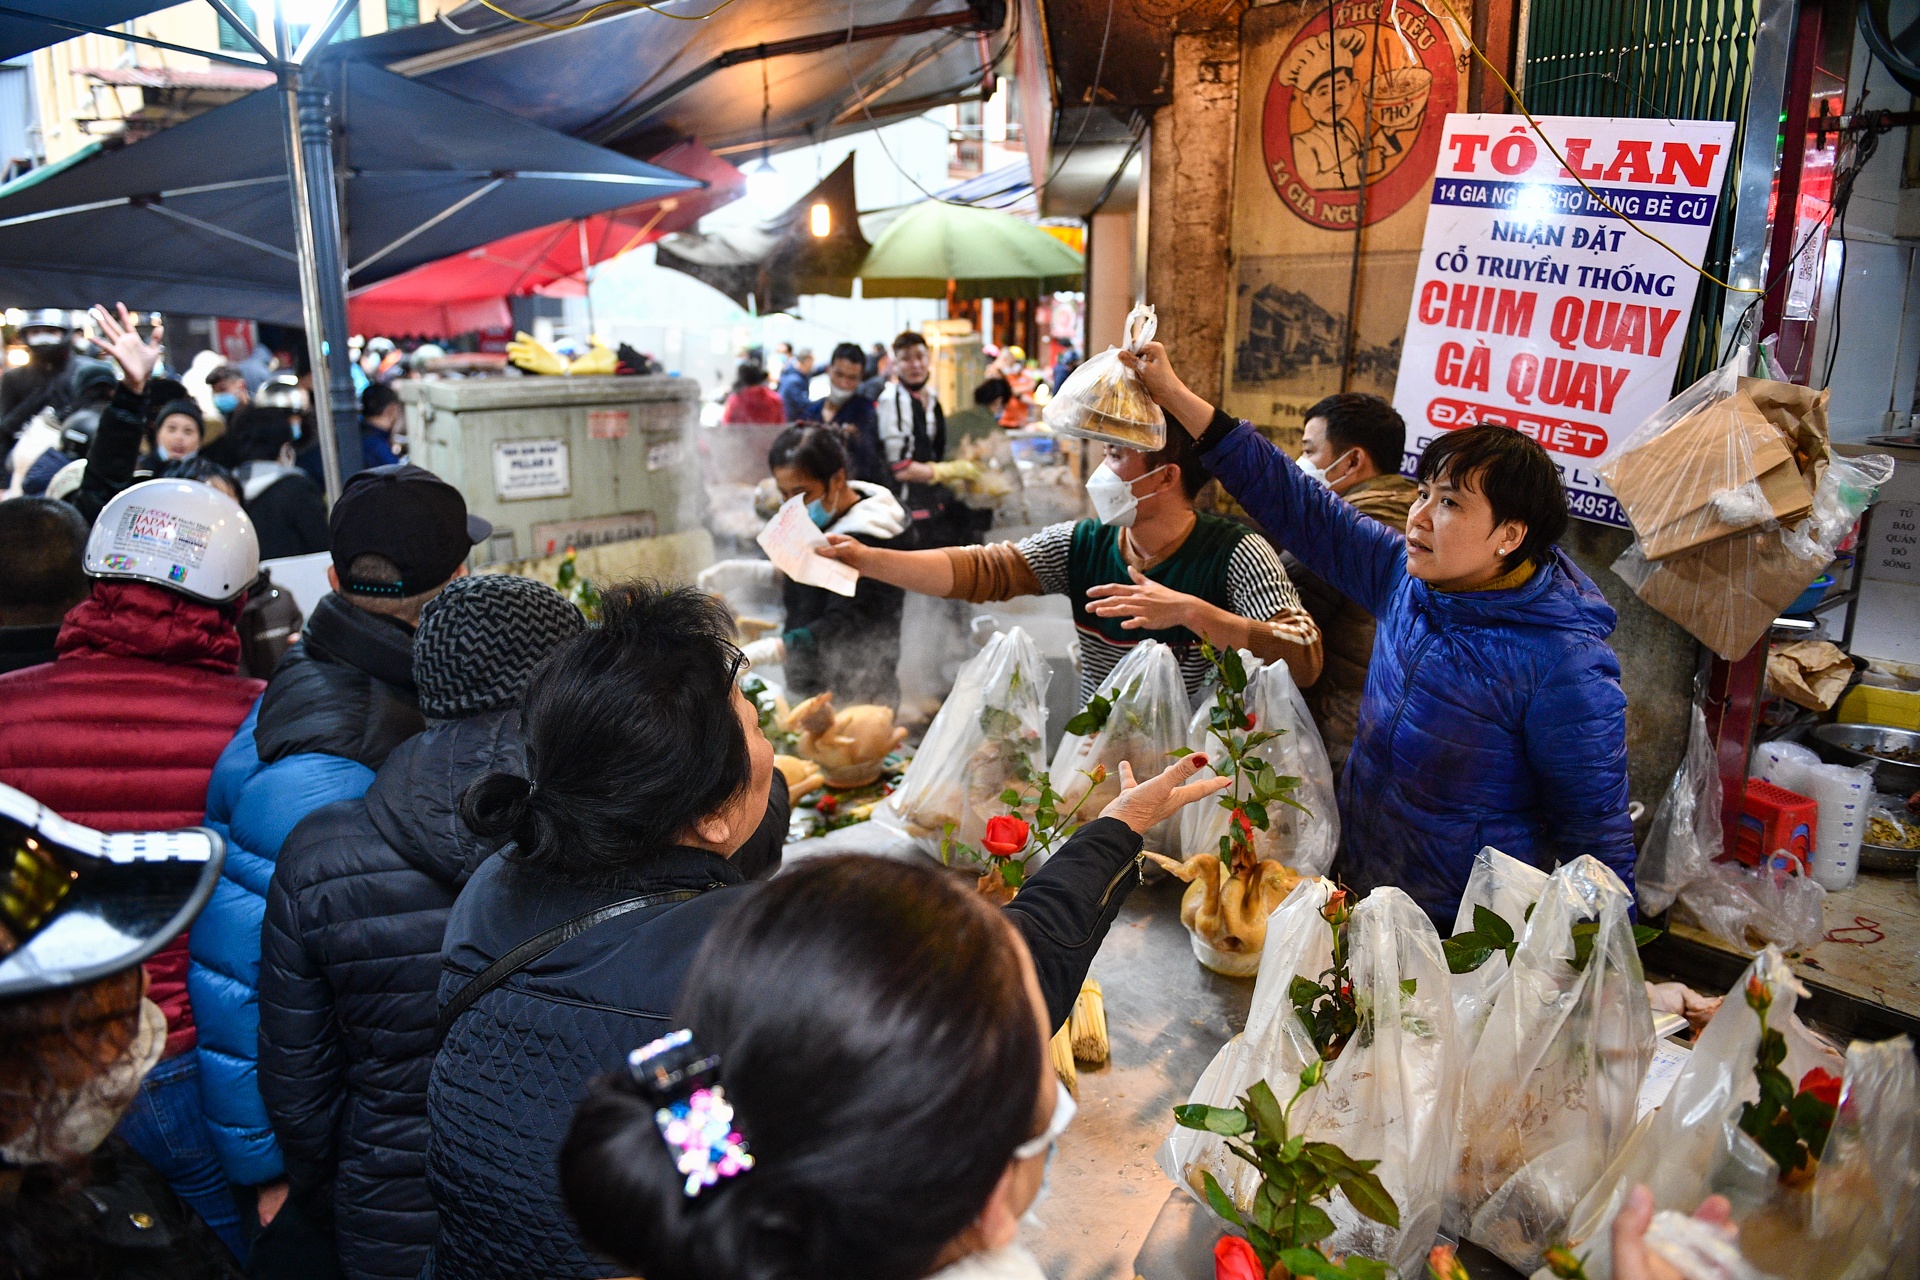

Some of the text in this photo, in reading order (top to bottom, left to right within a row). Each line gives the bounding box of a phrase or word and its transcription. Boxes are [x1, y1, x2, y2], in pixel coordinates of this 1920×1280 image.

[1449, 121, 1721, 188] TỐ LAN
[1287, 183, 1316, 217] GIA
[1439, 184, 1456, 201] 14
[1459, 185, 1488, 203] GIA
[1586, 192, 1640, 216] HÀNG
[1645, 194, 1673, 218] BÈ
[1677, 198, 1710, 220] CŨ
[1491, 219, 1627, 255] NHẬN ĐẶT
[1435, 245, 1676, 297] CỖ TRUYỀN THỐNG
[1418, 280, 1682, 358] CHIM QUAY
[1434, 338, 1631, 415] GÀ QUAY
[1517, 420, 1604, 452] BIỆT
